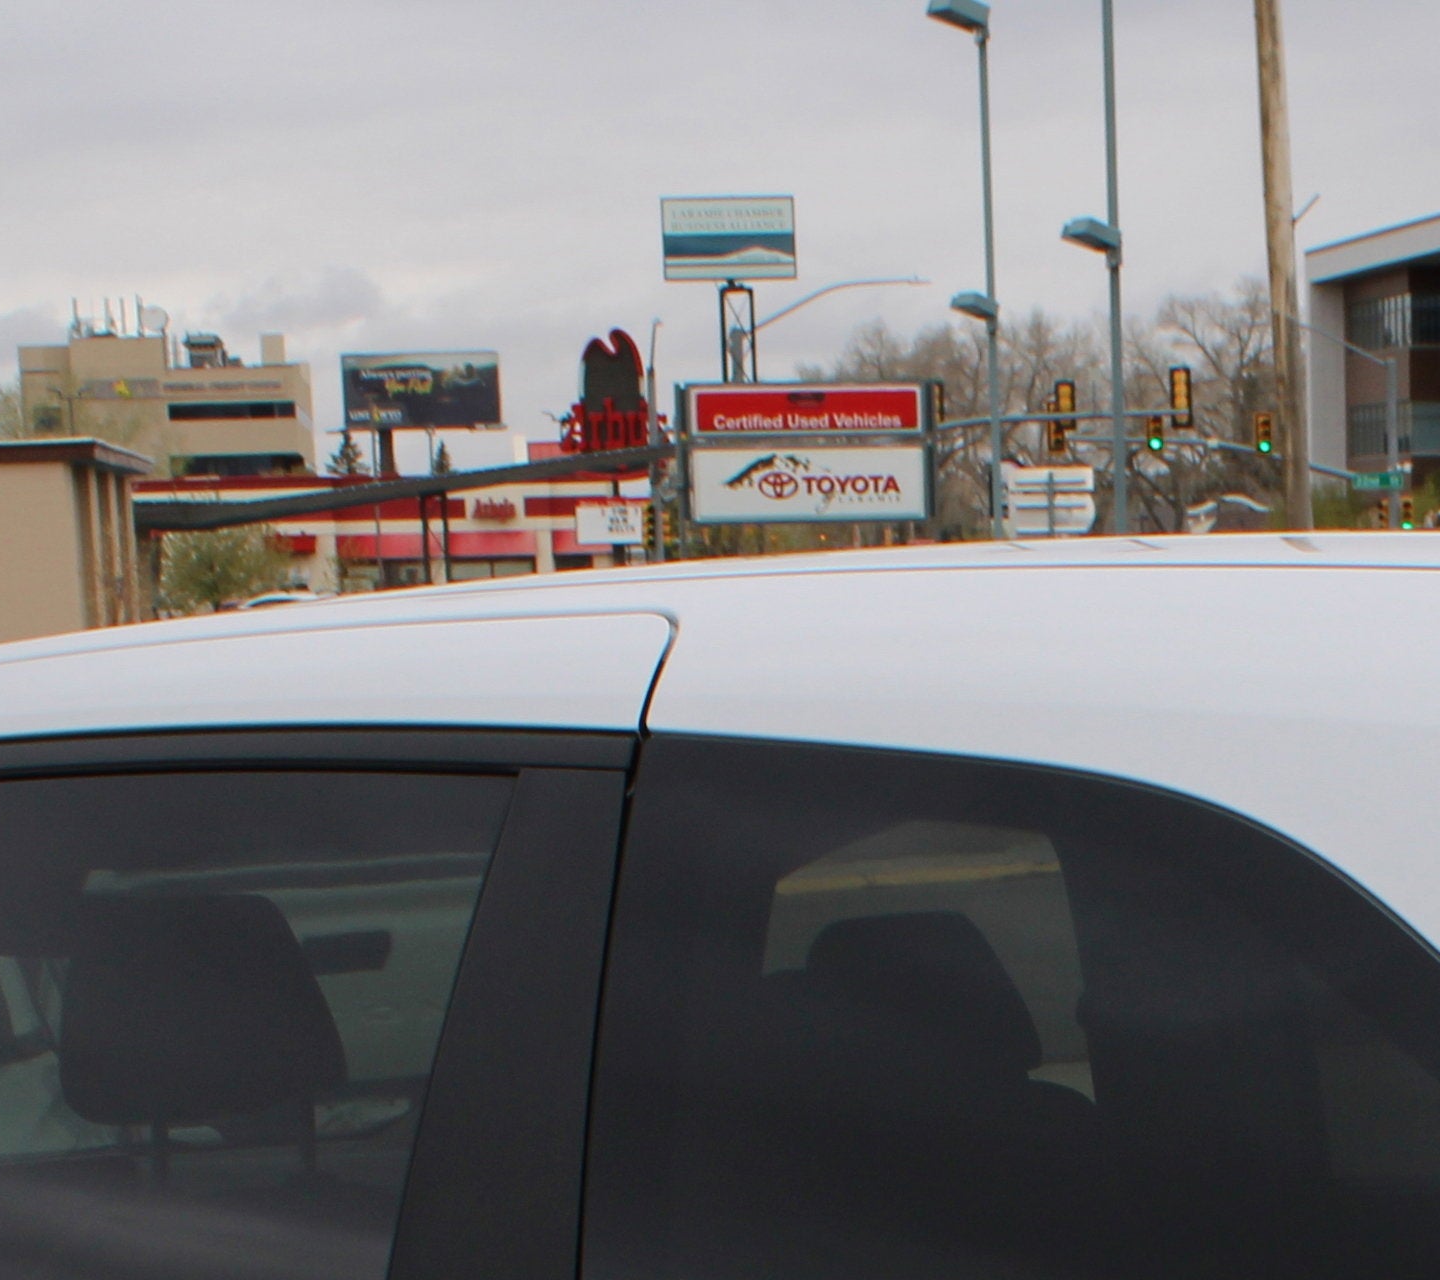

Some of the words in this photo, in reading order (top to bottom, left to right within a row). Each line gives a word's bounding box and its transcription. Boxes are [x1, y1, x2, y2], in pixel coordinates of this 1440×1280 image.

[713, 413, 783, 430] Certified
[787, 412, 829, 430] Used
[833, 411, 902, 429] Vehicles
[802, 475, 901, 495] TOYOTA
